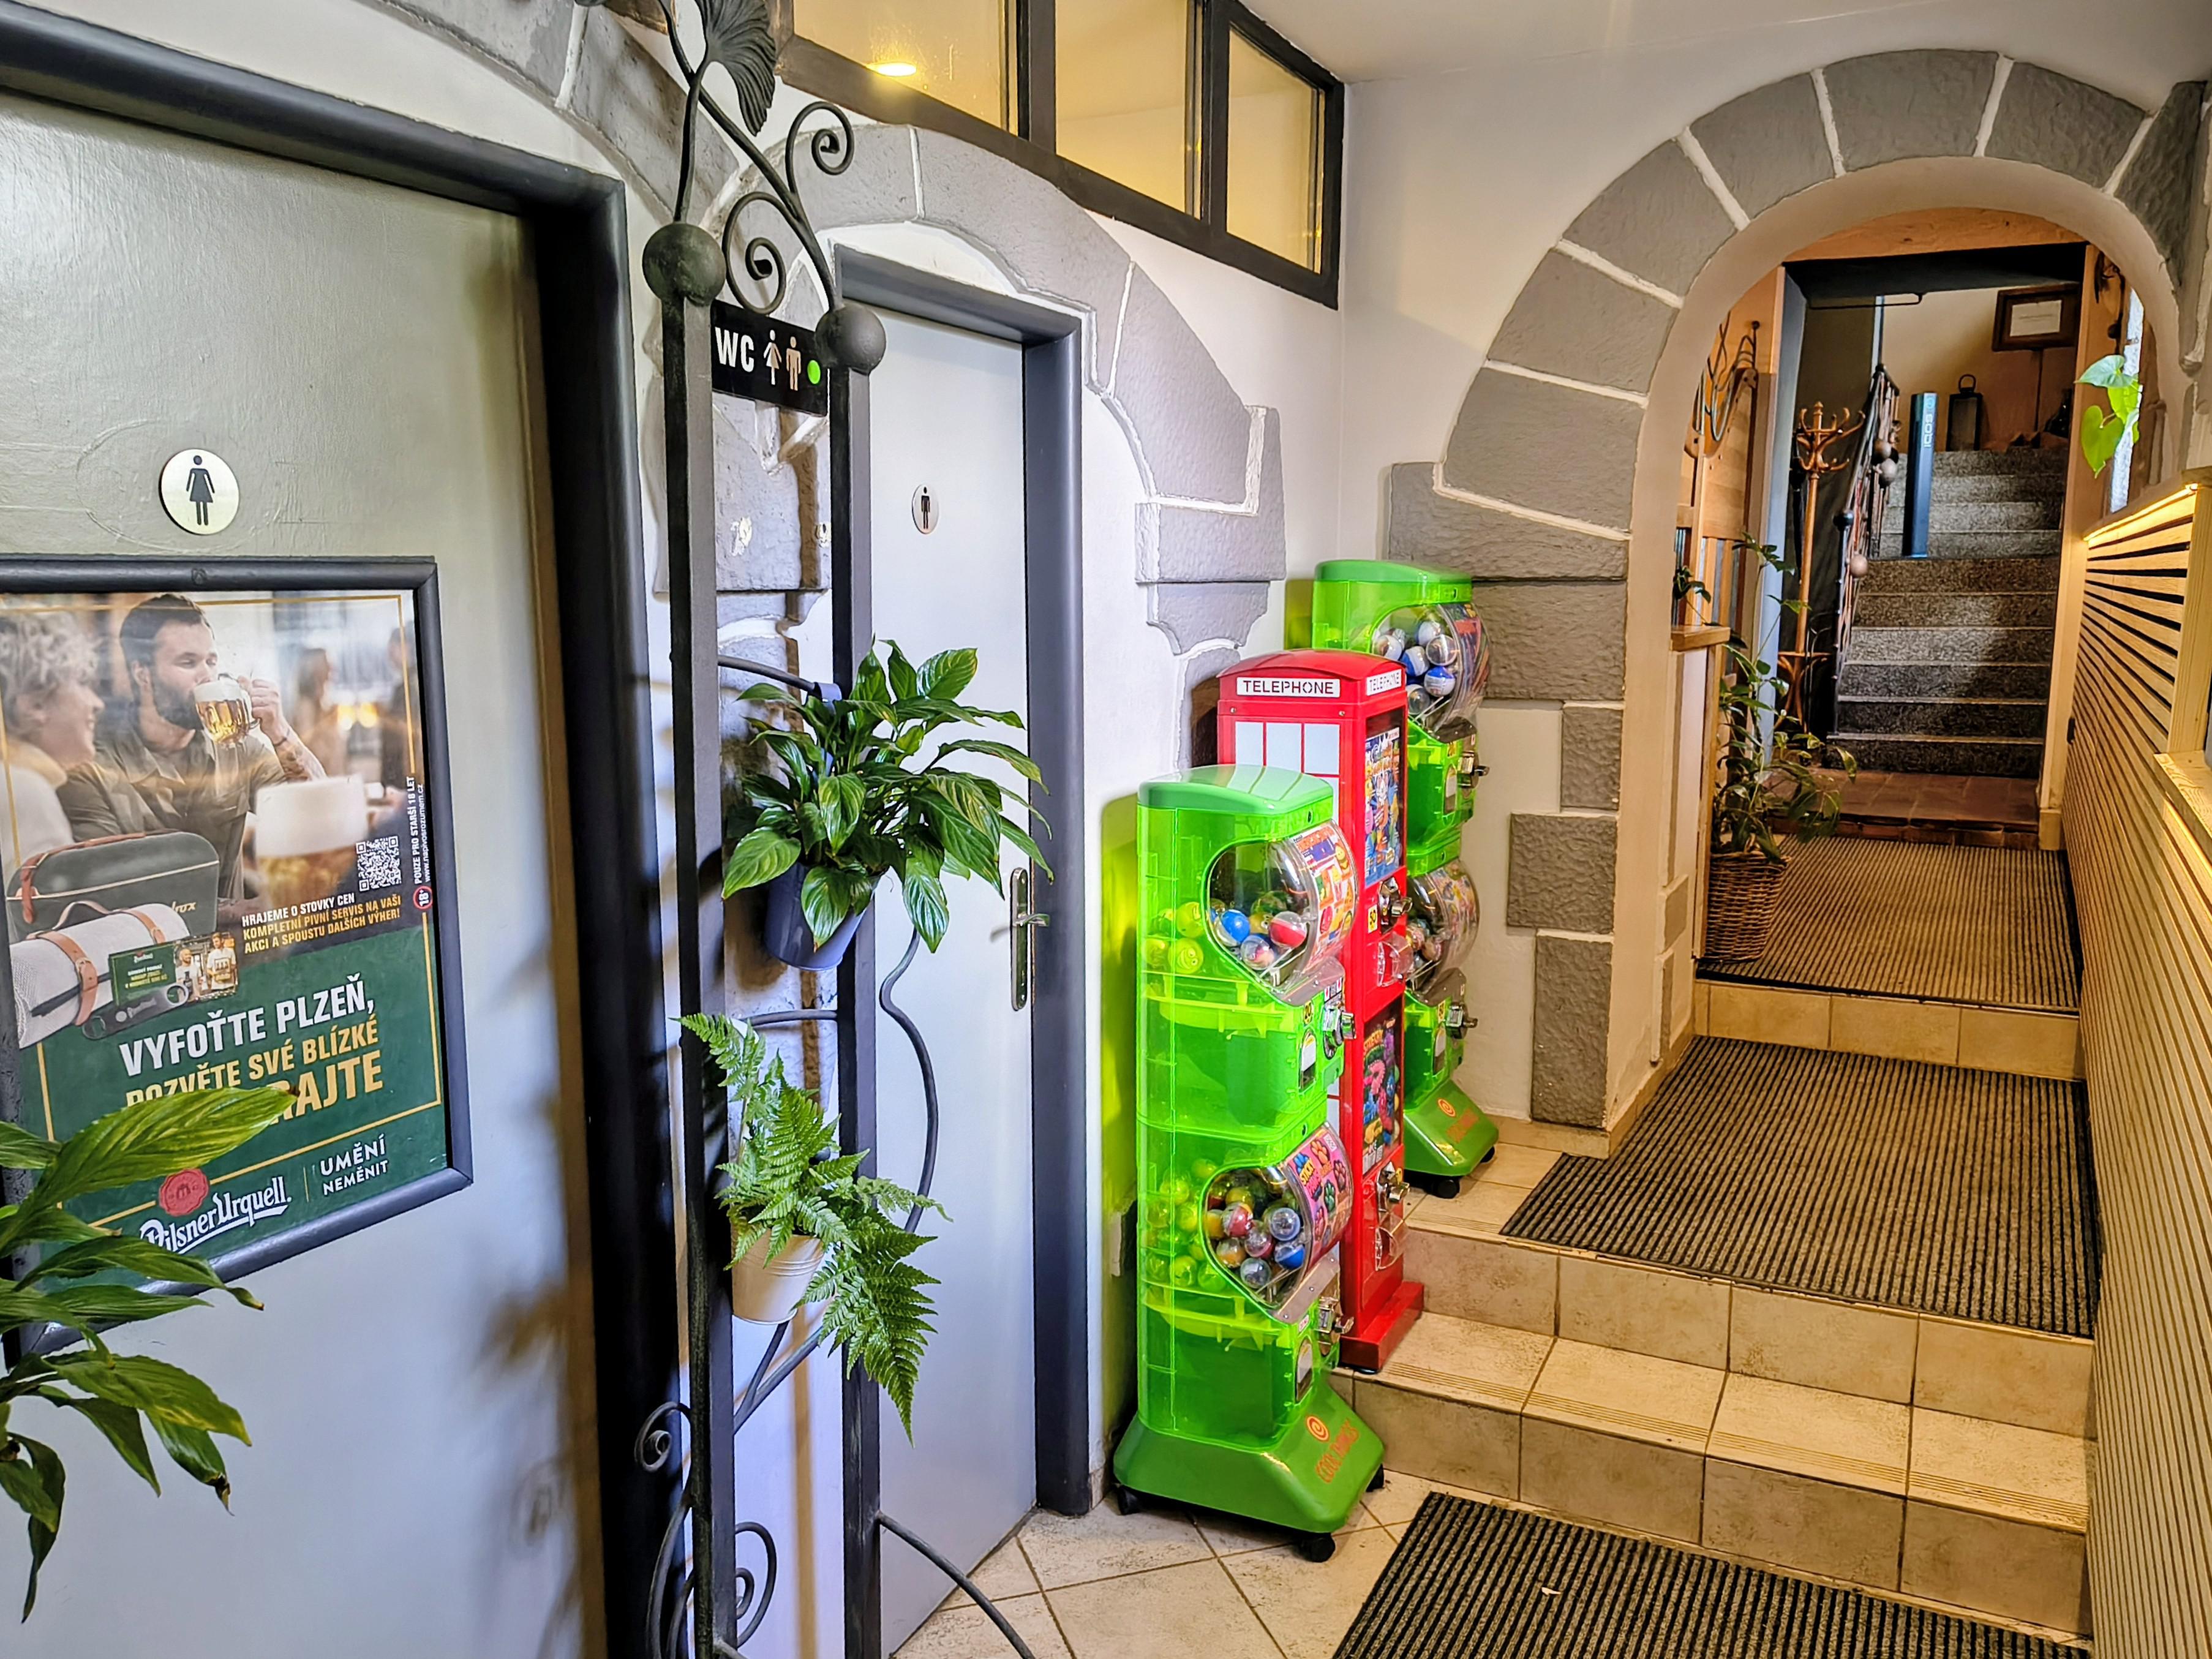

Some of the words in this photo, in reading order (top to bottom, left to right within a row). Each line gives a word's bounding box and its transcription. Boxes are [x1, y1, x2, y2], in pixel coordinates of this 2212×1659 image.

[715, 326, 754, 372] WC
[1243, 680, 1334, 694] TELEPHONE
[406, 776, 415, 791] LET
[407, 792, 416, 805] 18
[407, 807, 418, 837] STARŠÍ
[417, 783, 431, 882] www.napivosrozumem.cz
[411, 838, 420, 856] PRO
[413, 857, 423, 884] POUZE
[242, 908, 289, 927] HRAJEME
[291, 906, 298, 916] O
[300, 897, 335, 915] STOVKY
[337, 893, 355, 906] CEN
[243, 915, 301, 941] KOMPLETNÍ
[304, 911, 329, 927] PIVNÍ
[332, 903, 364, 920] SERVIS
[366, 901, 379, 913] NA
[380, 893, 401, 908] VAŠI
[244, 939, 269, 954] AKCI
[272, 938, 279, 947] A
[282, 925, 325, 945] SPOUSTU
[328, 916, 366, 935] DALŠÍCH
[368, 908, 400, 925] VÝHER!
[119, 1007, 266, 1077] VYFOŤTE
[276, 972, 374, 1034] PLZEŇ,
[249, 1038, 295, 1080] SVÉ
[302, 1013, 379, 1065] BLÍZKÉ
[320, 1133, 386, 1176] UMĚNÍ
[323, 1160, 389, 1196] NEMĚNIT
[139, 1211, 217, 1254] Pilsner
